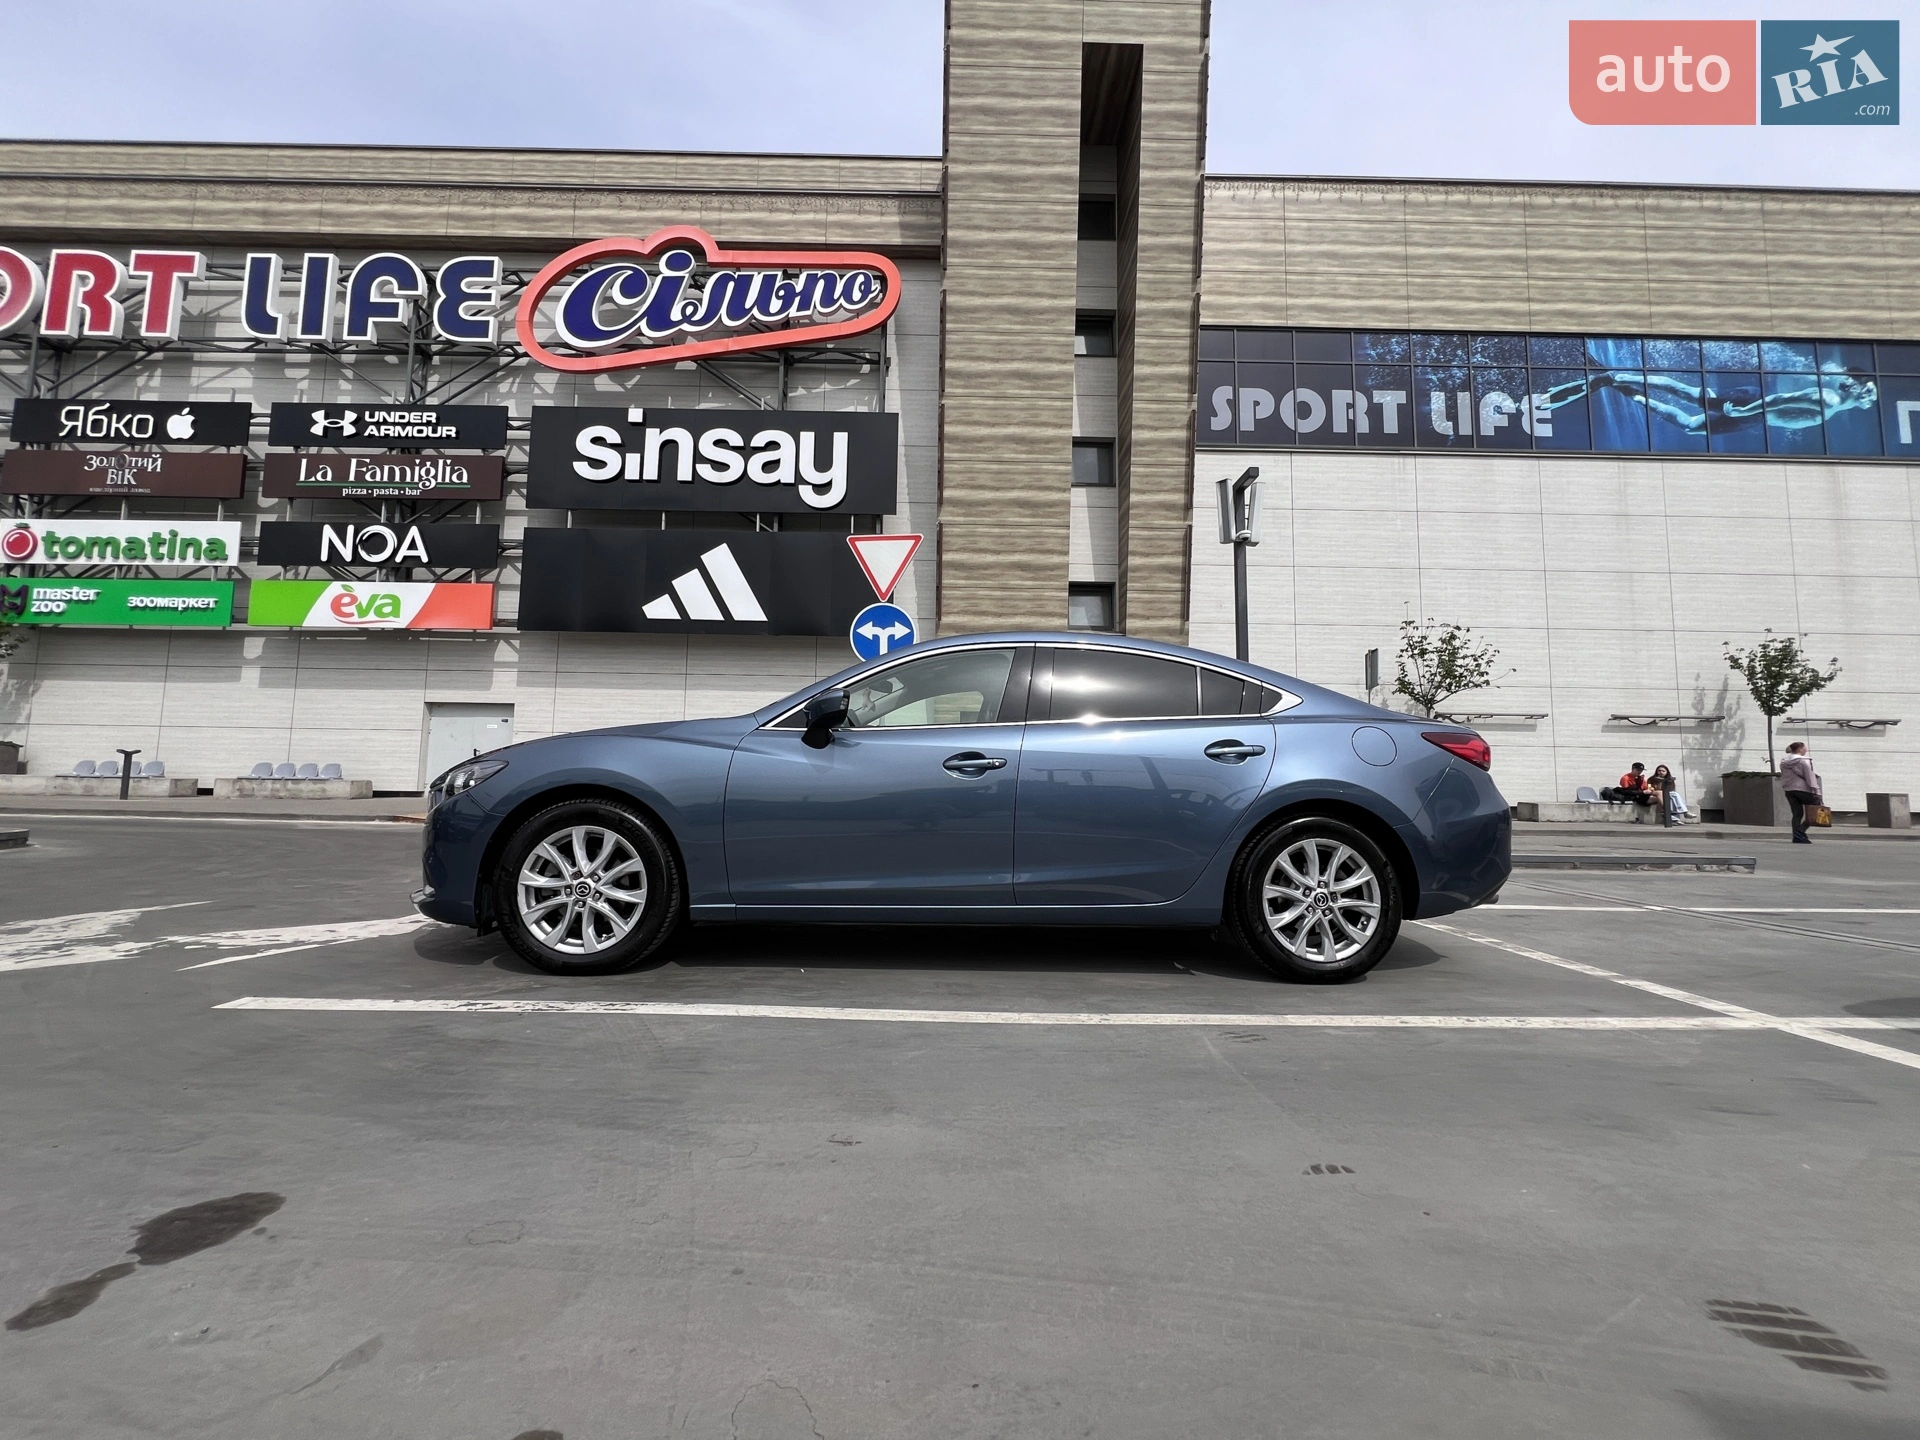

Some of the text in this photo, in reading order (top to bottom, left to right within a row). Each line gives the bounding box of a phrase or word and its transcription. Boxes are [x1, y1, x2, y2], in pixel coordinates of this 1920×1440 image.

[240, 252, 503, 346] LIFE
[555, 250, 882, 353] Сільпо
[59, 403, 154, 438] Ябко
[364, 411, 437, 424] UNDER
[1210, 385, 1553, 437] SPORT LIFE
[363, 425, 457, 438] ARMOUR
[300, 458, 469, 490] La Famiglia
[572, 408, 848, 509] sinsay
[342, 487, 422, 497] pizza pasta bar
[41, 529, 229, 561] tomatina
[320, 524, 429, 563] NOA
[30, 600, 67, 613] zoo
[32, 586, 102, 600] master
[127, 596, 219, 611] зоомаркет
